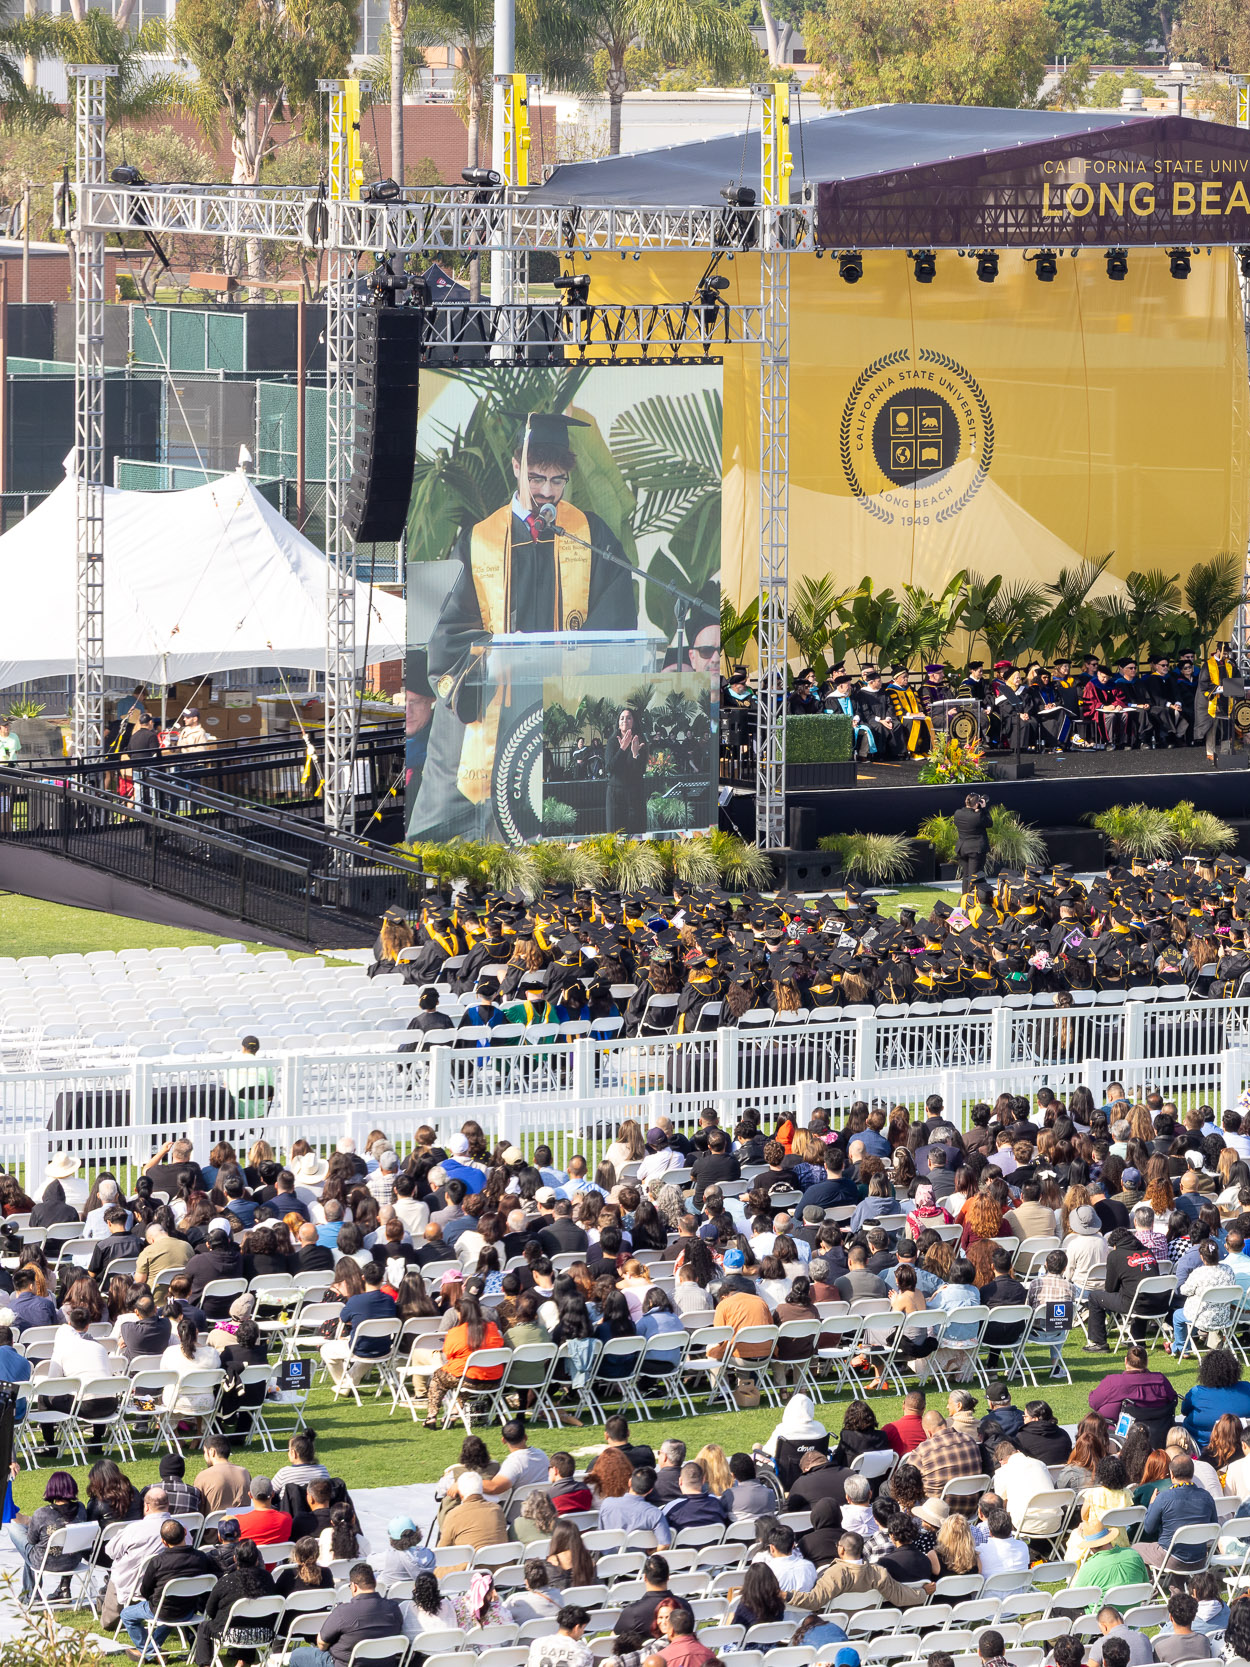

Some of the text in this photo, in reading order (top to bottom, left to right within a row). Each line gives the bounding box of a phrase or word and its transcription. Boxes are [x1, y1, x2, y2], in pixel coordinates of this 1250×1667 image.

[1043, 160, 1147, 174] CALIFORNIA
[1154, 160, 1203, 173] STATE
[1042, 181, 1155, 217] LONG
[856, 370, 977, 451] CALIFORNIA STATE UNIVERSITY
[878, 486, 953, 508] LONG BEACH
[901, 516, 930, 526] 1949
[513, 732, 544, 799] CALIFORNI
[540, 1646, 575, 1661] BAPE
